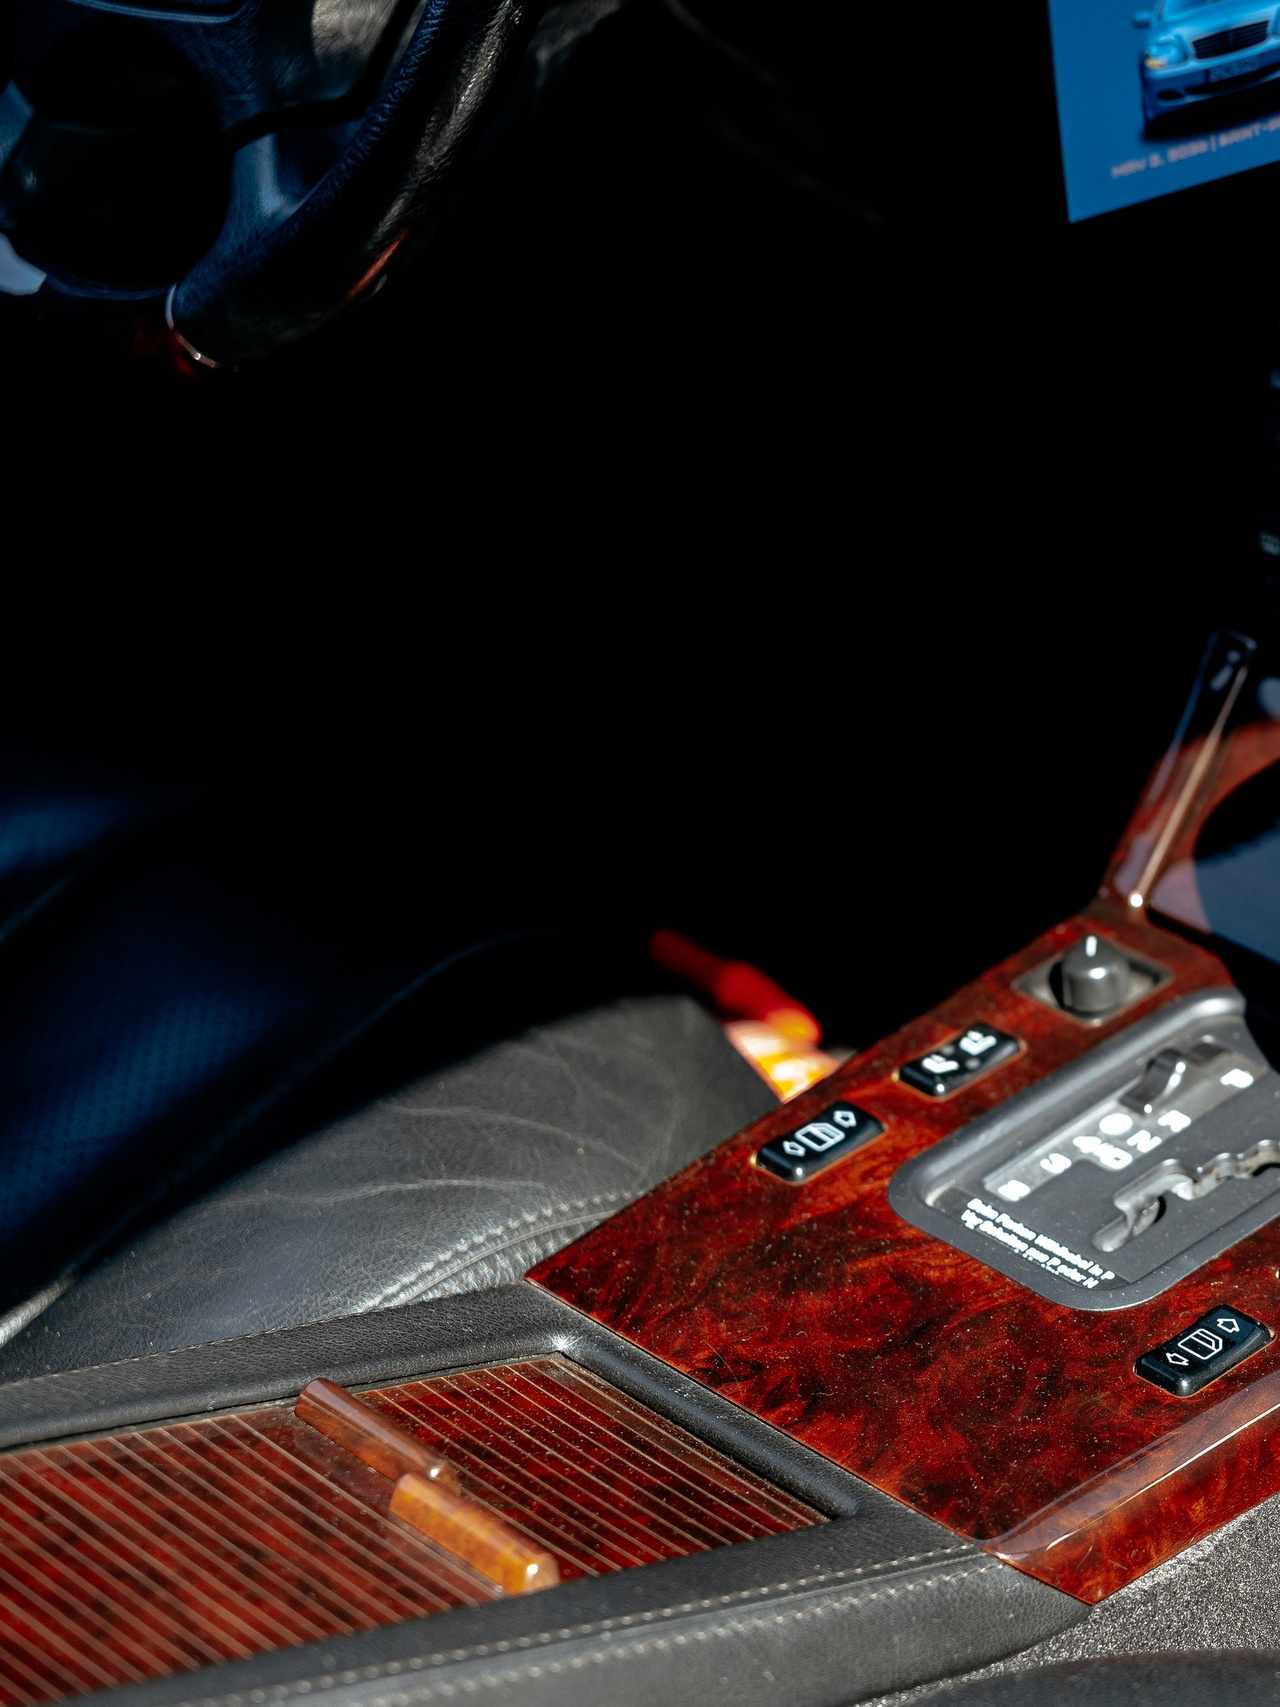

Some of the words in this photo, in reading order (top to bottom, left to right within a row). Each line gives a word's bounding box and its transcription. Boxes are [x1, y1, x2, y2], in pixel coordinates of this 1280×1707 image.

[1126, 1129, 1162, 1153] N
[1100, 1270, 1116, 1280] P
[1082, 1276, 1099, 1289] N
